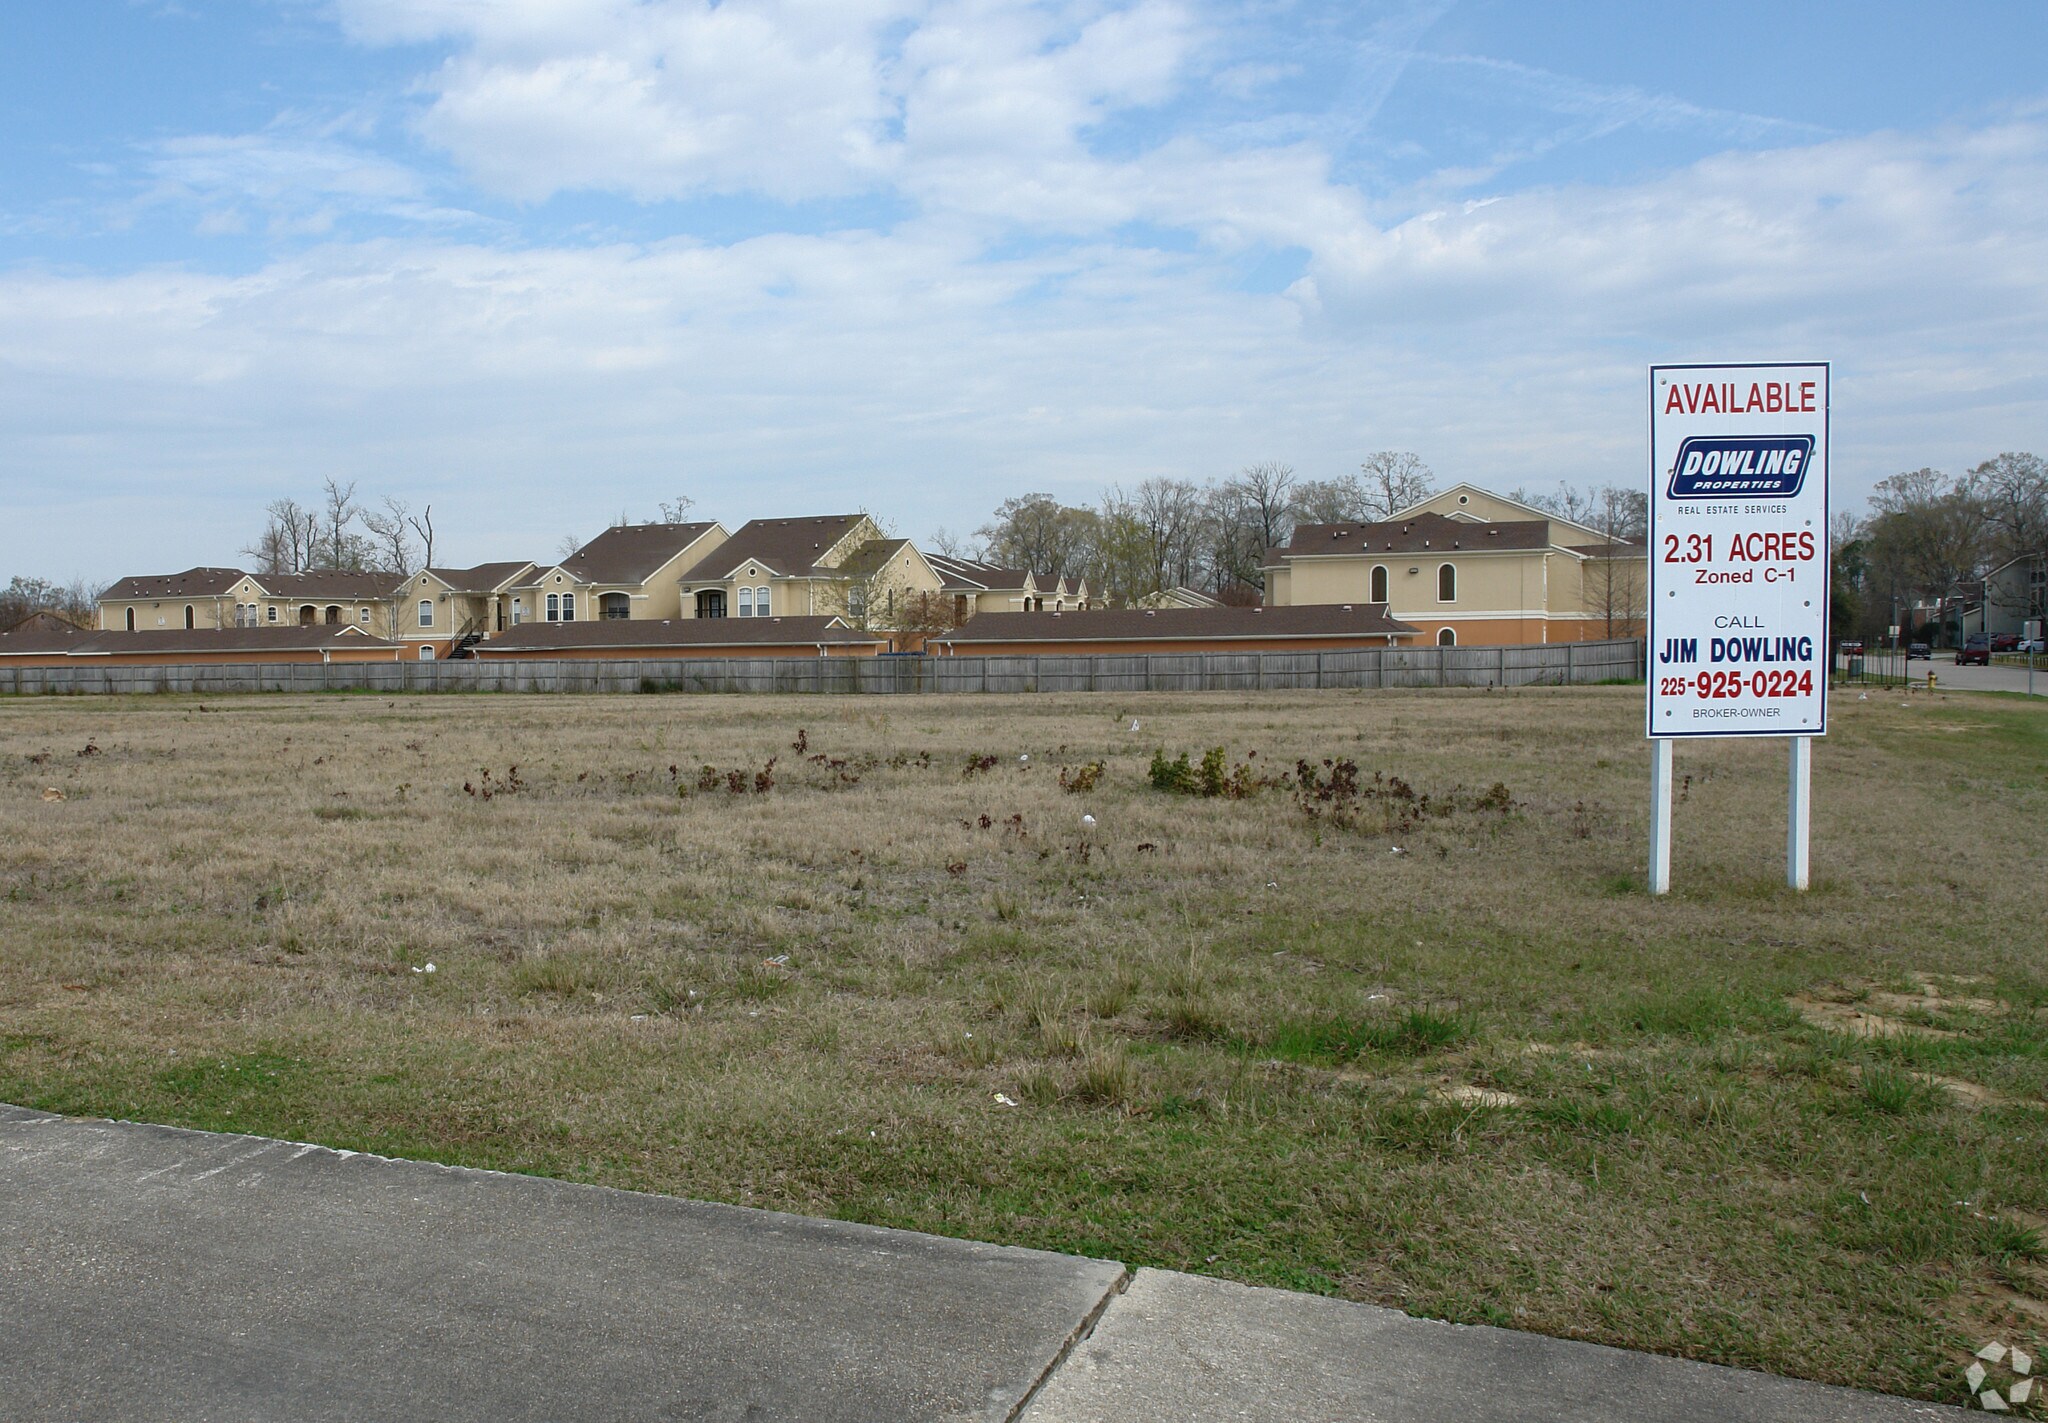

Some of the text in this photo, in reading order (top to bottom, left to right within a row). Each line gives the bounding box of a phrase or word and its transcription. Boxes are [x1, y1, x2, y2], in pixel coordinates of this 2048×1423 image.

[1665, 382, 1816, 414] AVAILABLE
[1682, 449, 1801, 476] DOWLING
[1693, 480, 1782, 490] PROPERTIES
[1678, 504, 1787, 515] REAL ESTATE SERVICES
[1664, 531, 1815, 563] 2.31 ACRES
[1695, 567, 1795, 584] Zoned C-1
[1714, 615, 1765, 629] CALL
[1659, 636, 1813, 664] JIM DOWLING
[1660, 669, 1813, 699] 225-925-0224
[1693, 708, 1780, 718] BROKER-OWNER
